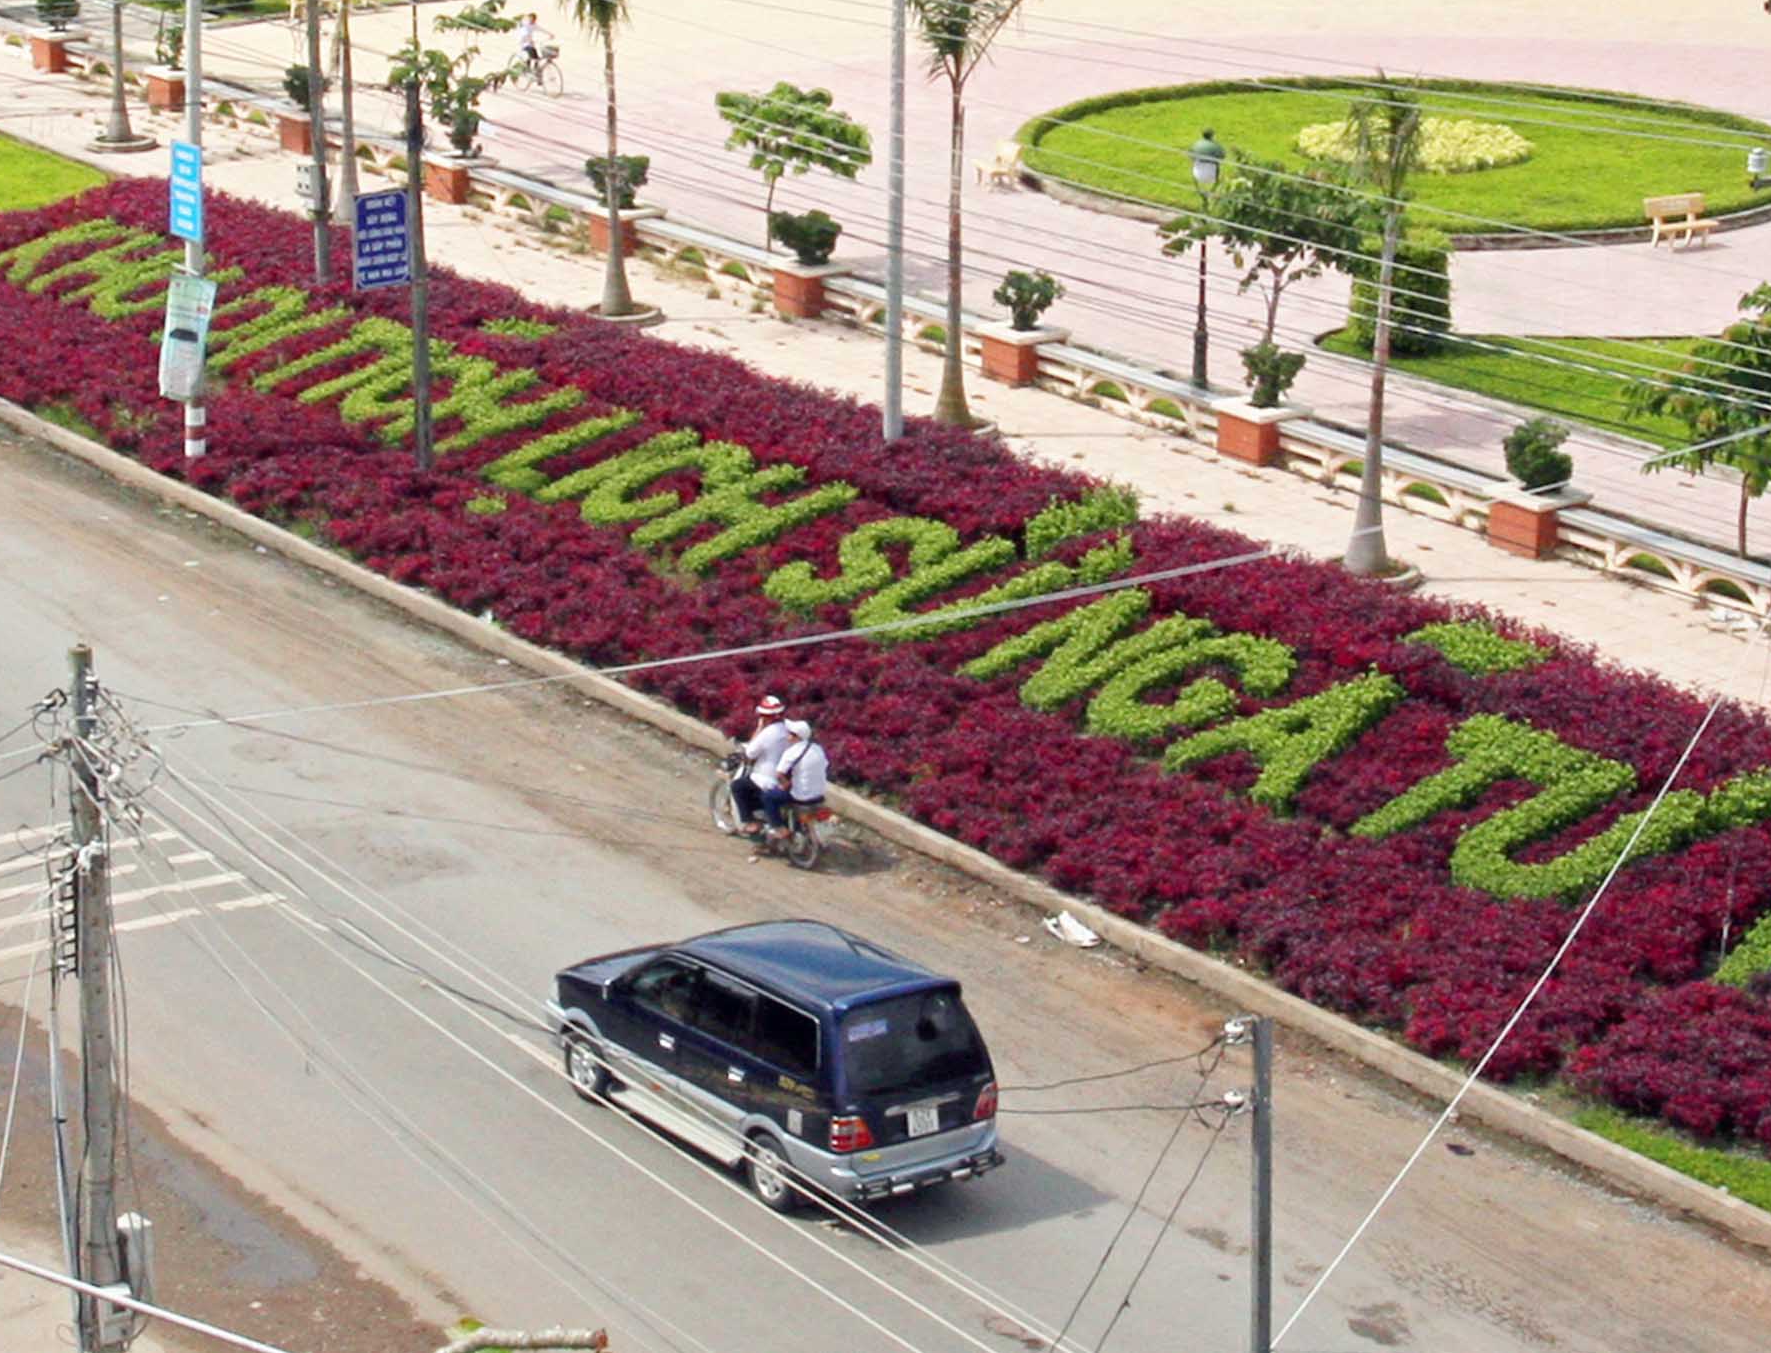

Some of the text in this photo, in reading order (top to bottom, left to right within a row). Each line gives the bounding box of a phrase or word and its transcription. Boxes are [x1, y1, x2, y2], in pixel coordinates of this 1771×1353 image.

[468, 409, 858, 571] LỊCH
[763, 483, 1138, 642] SỬ
[958, 588, 1550, 811] NGÃ
